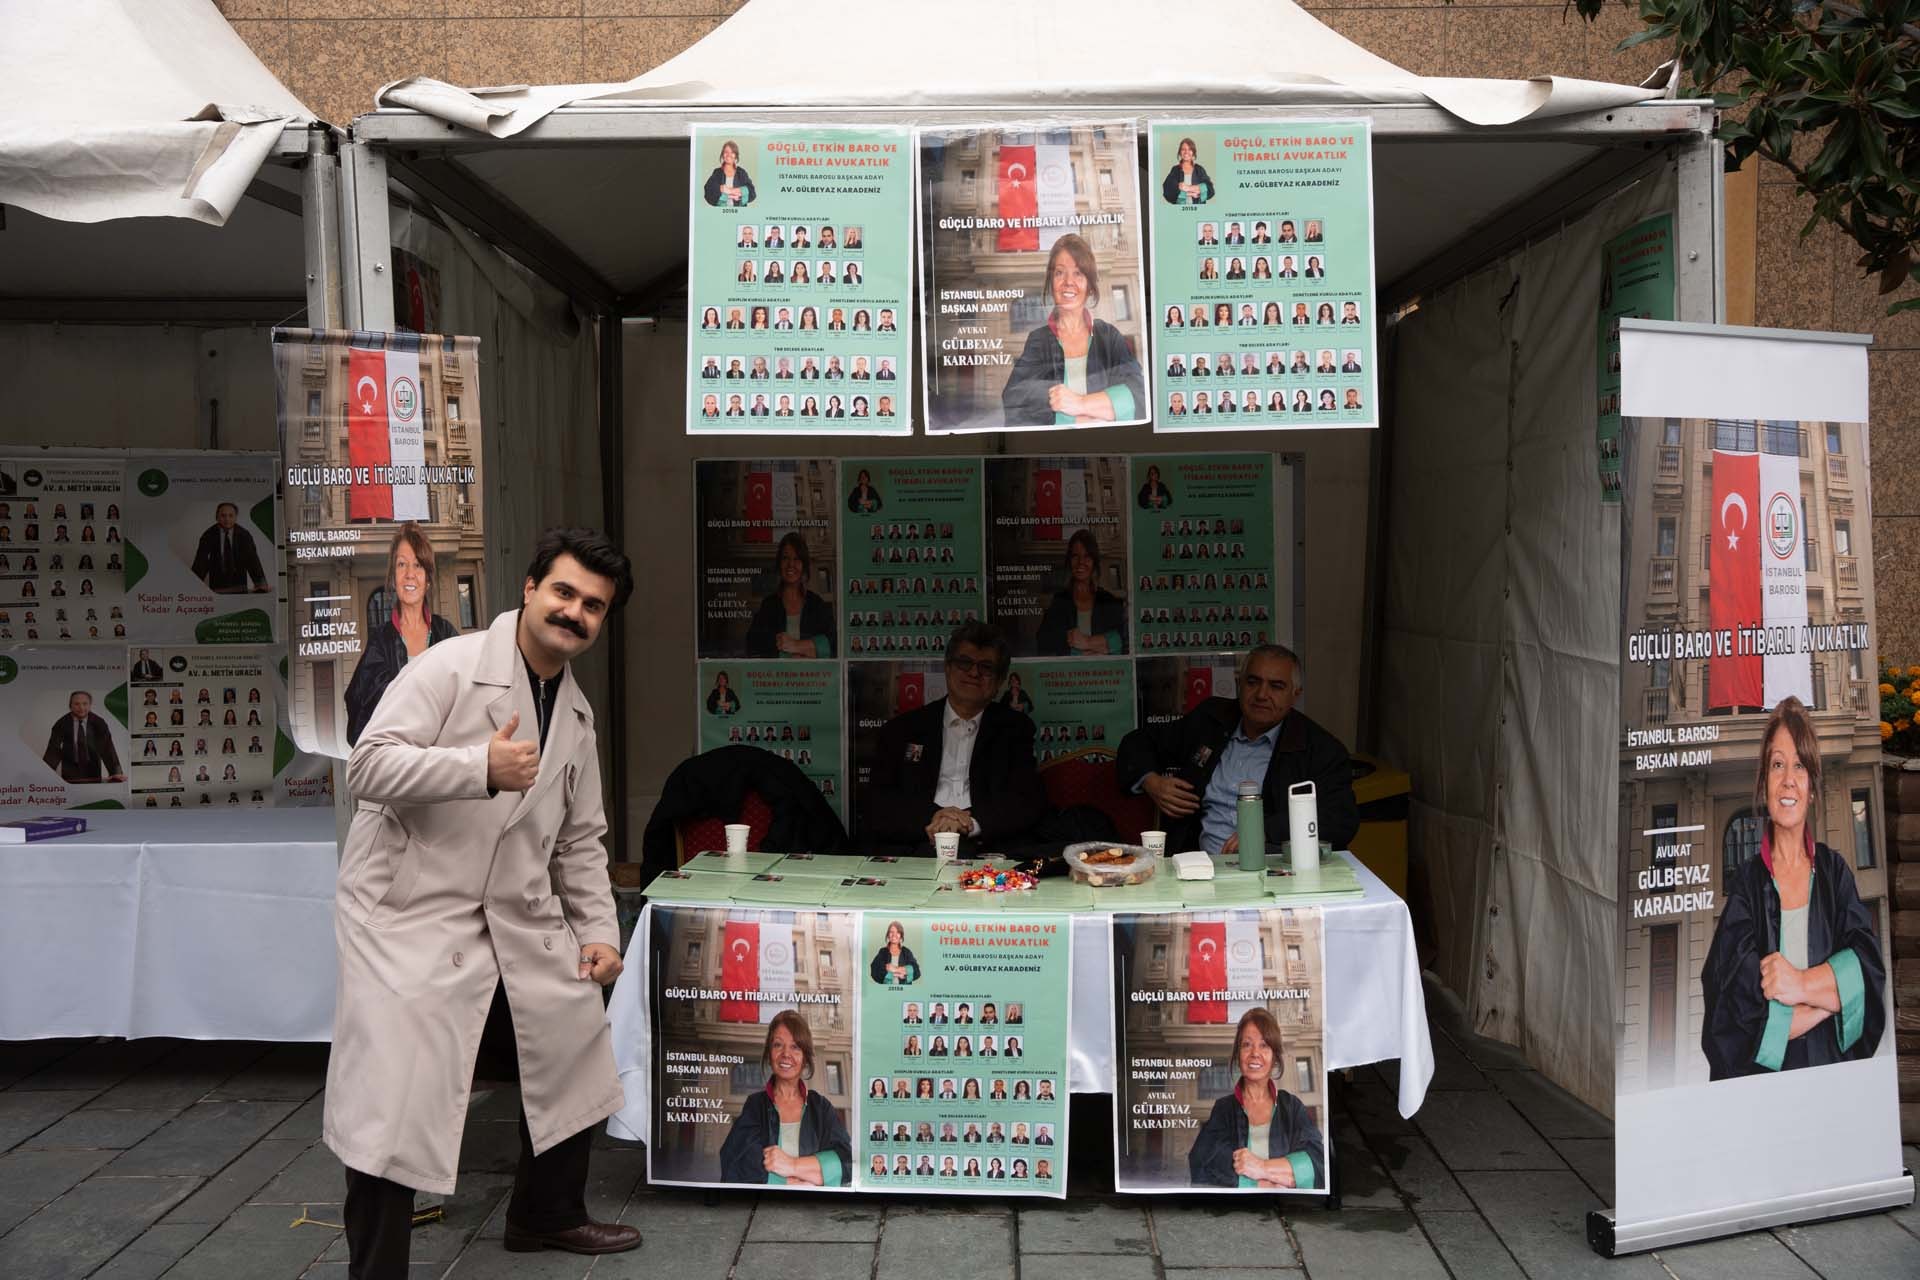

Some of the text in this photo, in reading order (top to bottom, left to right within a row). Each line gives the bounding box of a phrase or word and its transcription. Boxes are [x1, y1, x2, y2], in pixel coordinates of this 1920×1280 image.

[767, 141, 897, 154] GÜÇLÜ, ETKİN BARO VE
[1224, 136, 1354, 149] GÜÇLÜ, ETKİN BARO VE
[775, 155, 889, 167] İTİBARLI AVUKATLIK
[1233, 151, 1347, 162] İTİBARLI AVUKATLIK
[796, 185, 835, 193] GÜLBEYAZ
[1254, 180, 1294, 188] GÜLBEYAZ
[1295, 179, 1340, 187] KARADENİZ
[939, 213, 1125, 231] GÜÇLÜ BARO VE İTİBARLI AVUKATLIK
[941, 289, 1024, 300] İSTANBUL BAROSU
[941, 303, 1008, 315] BAŞKAN ADAYI
[958, 326, 987, 335] AVUKAT
[942, 337, 1004, 350] GÜLBEYAZ
[943, 353, 1012, 367] KARADENİZ
[391, 424, 421, 434] İSTANBUL
[288, 464, 475, 488] GÜÇLÜ BARO VE İTİBARLI AVUKATLIK
[290, 529, 361, 543] İSTANBUL BAROSU
[296, 546, 355, 561] BAŞKAN ADAYI
[1765, 567, 1803, 577] İSTANBUL
[1769, 585, 1800, 595] BAROSU
[314, 607, 341, 618] AVUKAT
[301, 619, 357, 638] GÜLBEYAZ
[299, 635, 361, 656] KARADENİZ
[1629, 624, 1869, 666] GÜÇLÜ BARO VE İTİBARLI AVUKATLIK
[1627, 725, 1720, 748] İSTANBUL BAROSU
[1636, 749, 1712, 772] BAŞKAN ADAYI
[28, 783, 65, 793] Sonuna
[0, 796, 23, 805] adar
[1656, 843, 1692, 859] AVUKAT
[1638, 864, 1710, 890] GÜLBEYAZ
[1633, 888, 1714, 918] KARADENİZ
[931, 922, 1057, 935] GÜÇLÜ, ETKİN BARO VE
[939, 935, 1049, 947] İTİBARLI AVUKATLIK
[959, 964, 997, 972] GÜLBEYAZ
[998, 965, 1041, 973] KARADENİZ
[665, 986, 841, 1004] GÜÇLÜ BARO VE İTİBARLI AVUKATLIK
[1131, 988, 1311, 1004] GÜÇLÜ BARO VE İTİBARLI AVUKATLIK
[666, 1051, 744, 1064] İSTANBUL BAROSU
[1131, 1058, 1212, 1068] İSTANBUL BAROSU
[666, 1064, 729, 1076] BAŞKAN ADAYI
[1132, 1070, 1196, 1082] BAŞKAN ADAYI
[681, 1086, 709, 1094] AVUKAT
[1147, 1091, 1176, 1100] AVUKAT
[666, 1096, 724, 1110] GÜLBEYAZ
[1132, 1101, 1191, 1115] GÜLBEYAZ
[666, 1110, 731, 1124] KARADENİZ
[1133, 1115, 1199, 1129] KARADENİZ
